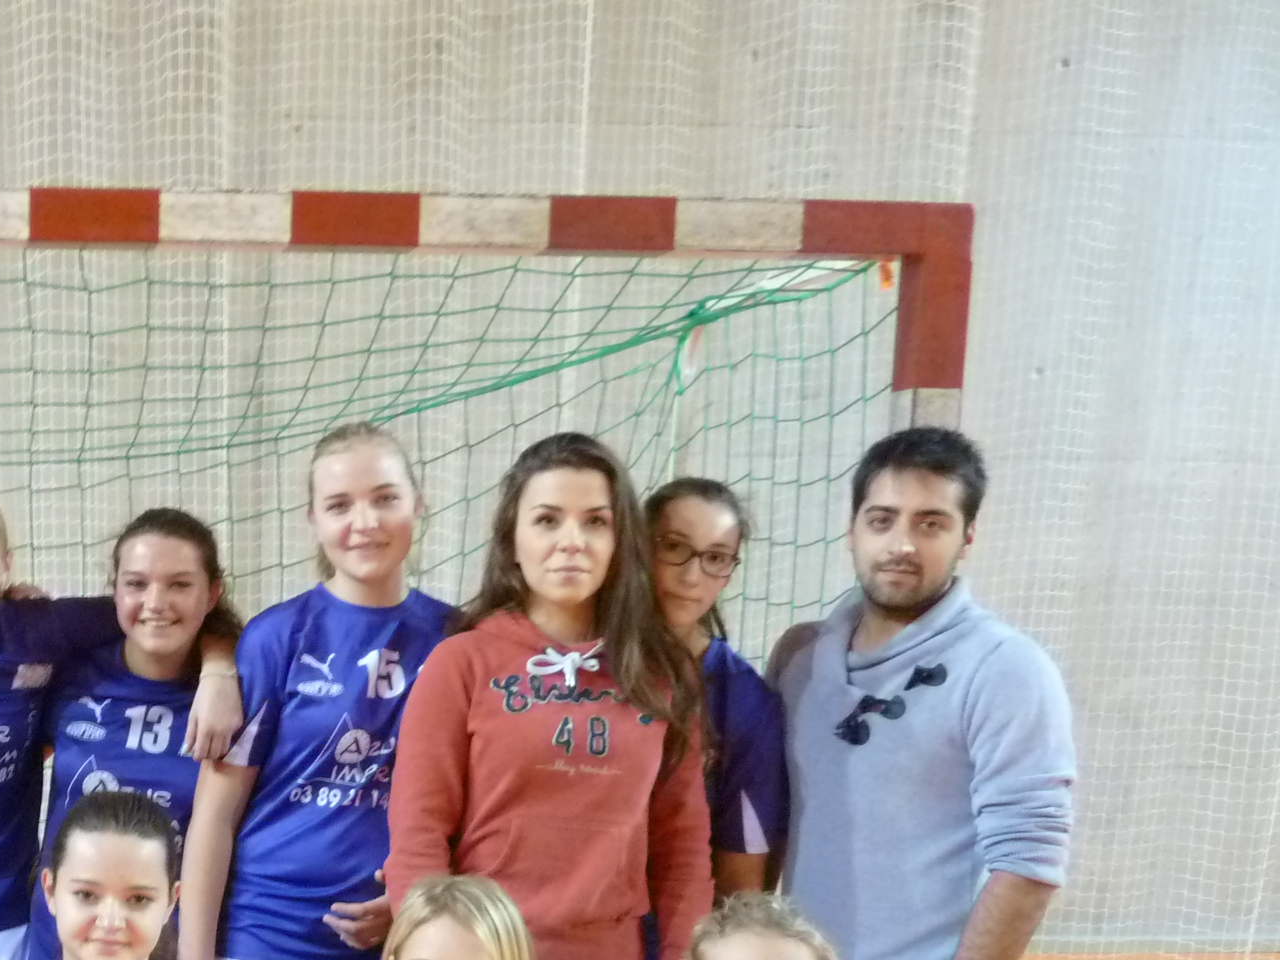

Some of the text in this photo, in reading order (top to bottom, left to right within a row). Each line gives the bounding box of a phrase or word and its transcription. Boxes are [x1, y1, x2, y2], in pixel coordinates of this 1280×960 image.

[356, 648, 406, 700] 15
[124, 705, 174, 754] 13
[289, 785, 313, 804] 03
[315, 787, 342, 808] 89
